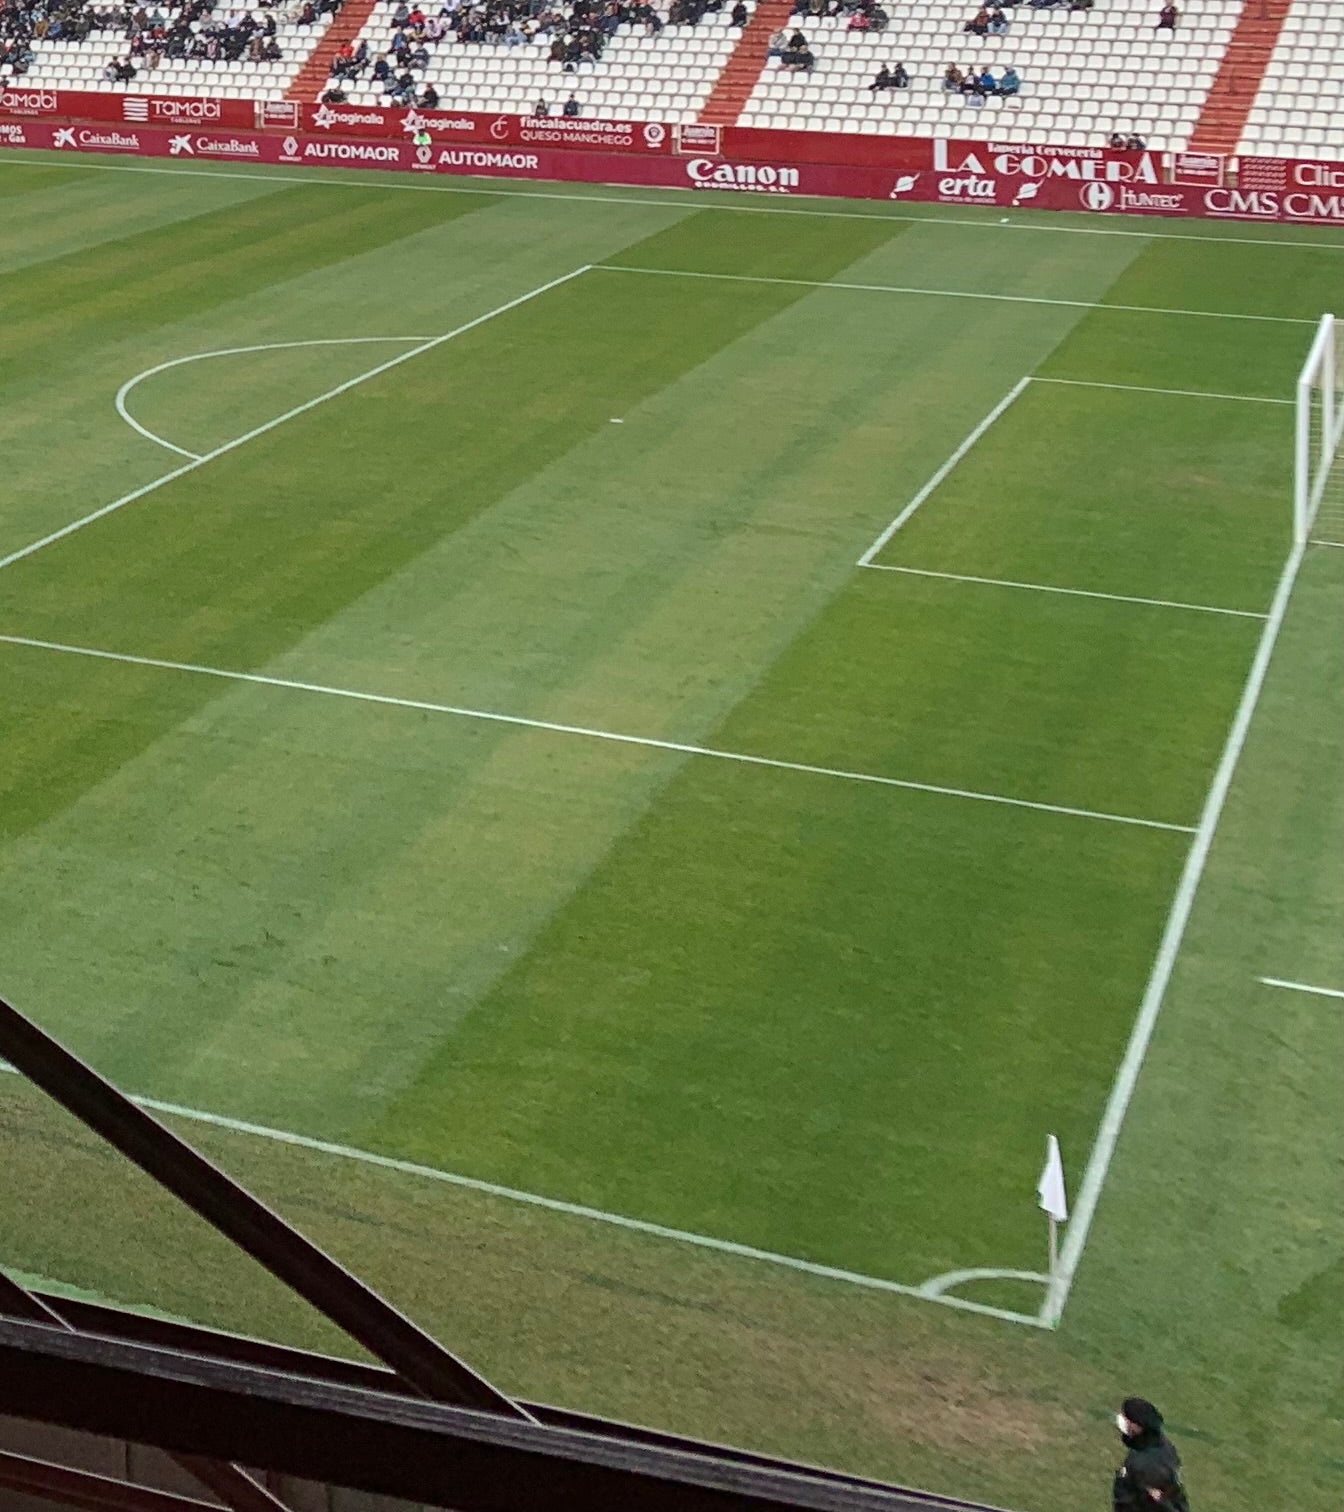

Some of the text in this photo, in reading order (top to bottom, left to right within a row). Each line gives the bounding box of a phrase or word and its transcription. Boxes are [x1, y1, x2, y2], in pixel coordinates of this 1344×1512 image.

[520, 114, 633, 136] fincalacuadra.es
[79, 129, 140, 148] CaixaBank
[195, 135, 259, 155] CaixaBank
[519, 131, 633, 148] QUESO MANCHEGO
[304, 142, 400, 162] AUTOMAOR
[440, 149, 539, 171] AUTOMAOR
[933, 138, 987, 175] LA
[994, 150, 1159, 186] GOMERA
[687, 158, 801, 188] Canon
[1204, 189, 1280, 215] CMS
